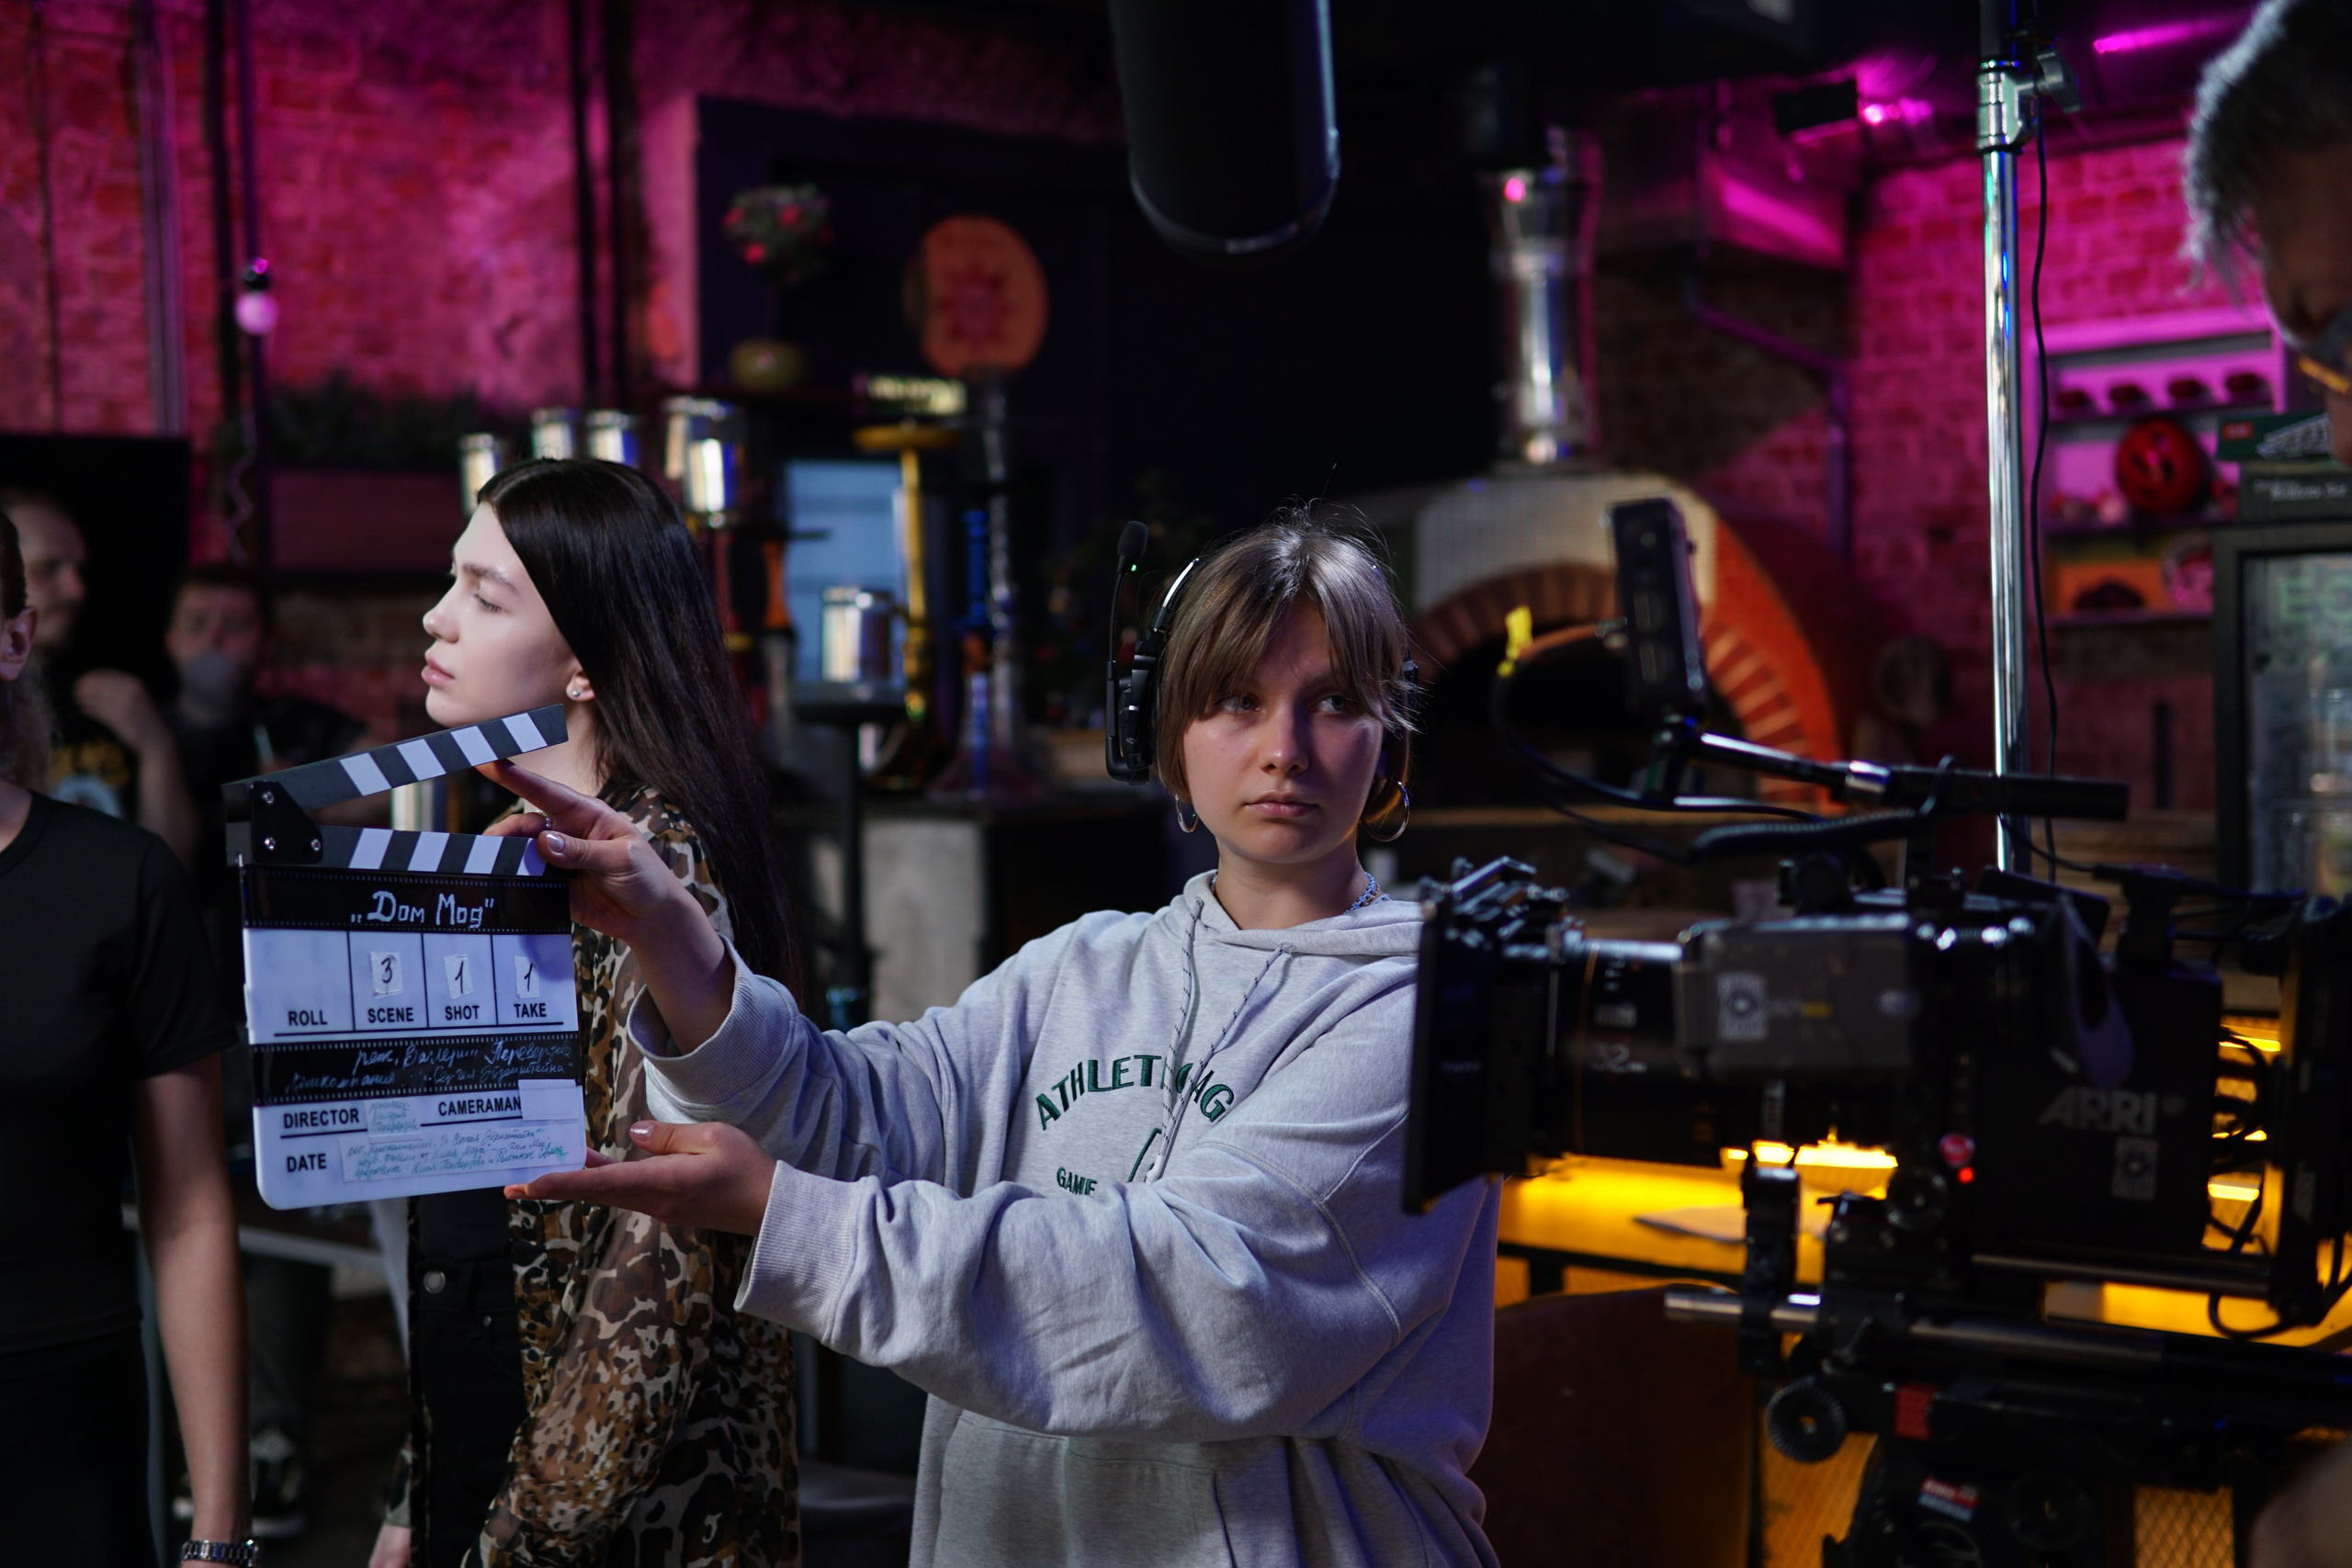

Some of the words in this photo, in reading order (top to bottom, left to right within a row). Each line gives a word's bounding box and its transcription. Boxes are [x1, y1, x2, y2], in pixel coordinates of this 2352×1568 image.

[381, 956, 393, 984] 3
[455, 960, 465, 995] 1
[524, 963, 534, 992] 1
[288, 1010, 328, 1026] ROLL
[368, 1007, 414, 1023] SCENE
[445, 1005, 480, 1021] SHOT
[514, 1002, 548, 1019] TAKE
[437, 1096, 522, 1117] CAMERAMAN
[2037, 1087, 2157, 1134] ARRI
[283, 1108, 359, 1129] DIRECTOR
[287, 1153, 327, 1173] DATE
